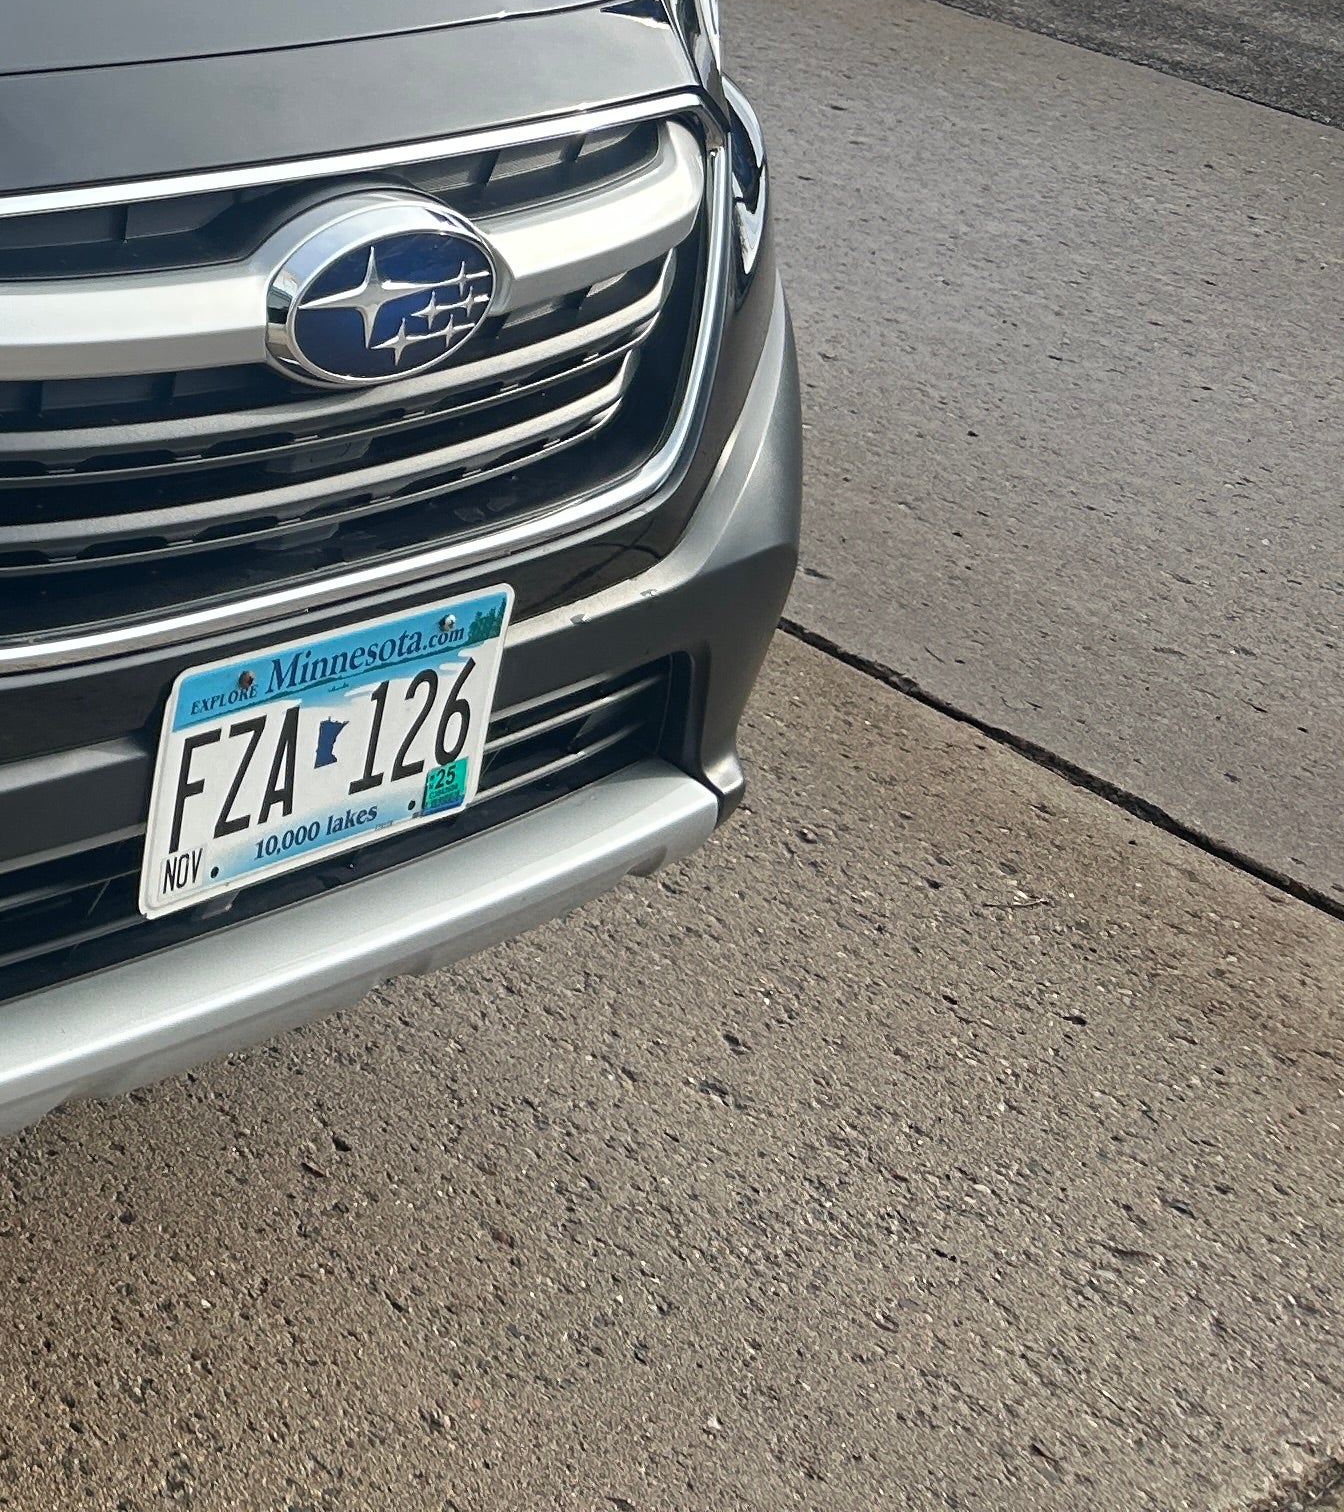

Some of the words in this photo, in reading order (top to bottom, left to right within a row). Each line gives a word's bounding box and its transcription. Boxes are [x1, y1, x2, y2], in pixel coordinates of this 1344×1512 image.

[190, 685, 259, 716] EXPLORE
[168, 705, 300, 855] FZA
[348, 656, 477, 796] 126
[435, 764, 457, 789] 25
[253, 821, 321, 860] 10,000
[326, 805, 378, 835] lakes
[162, 847, 204, 895] NOV
